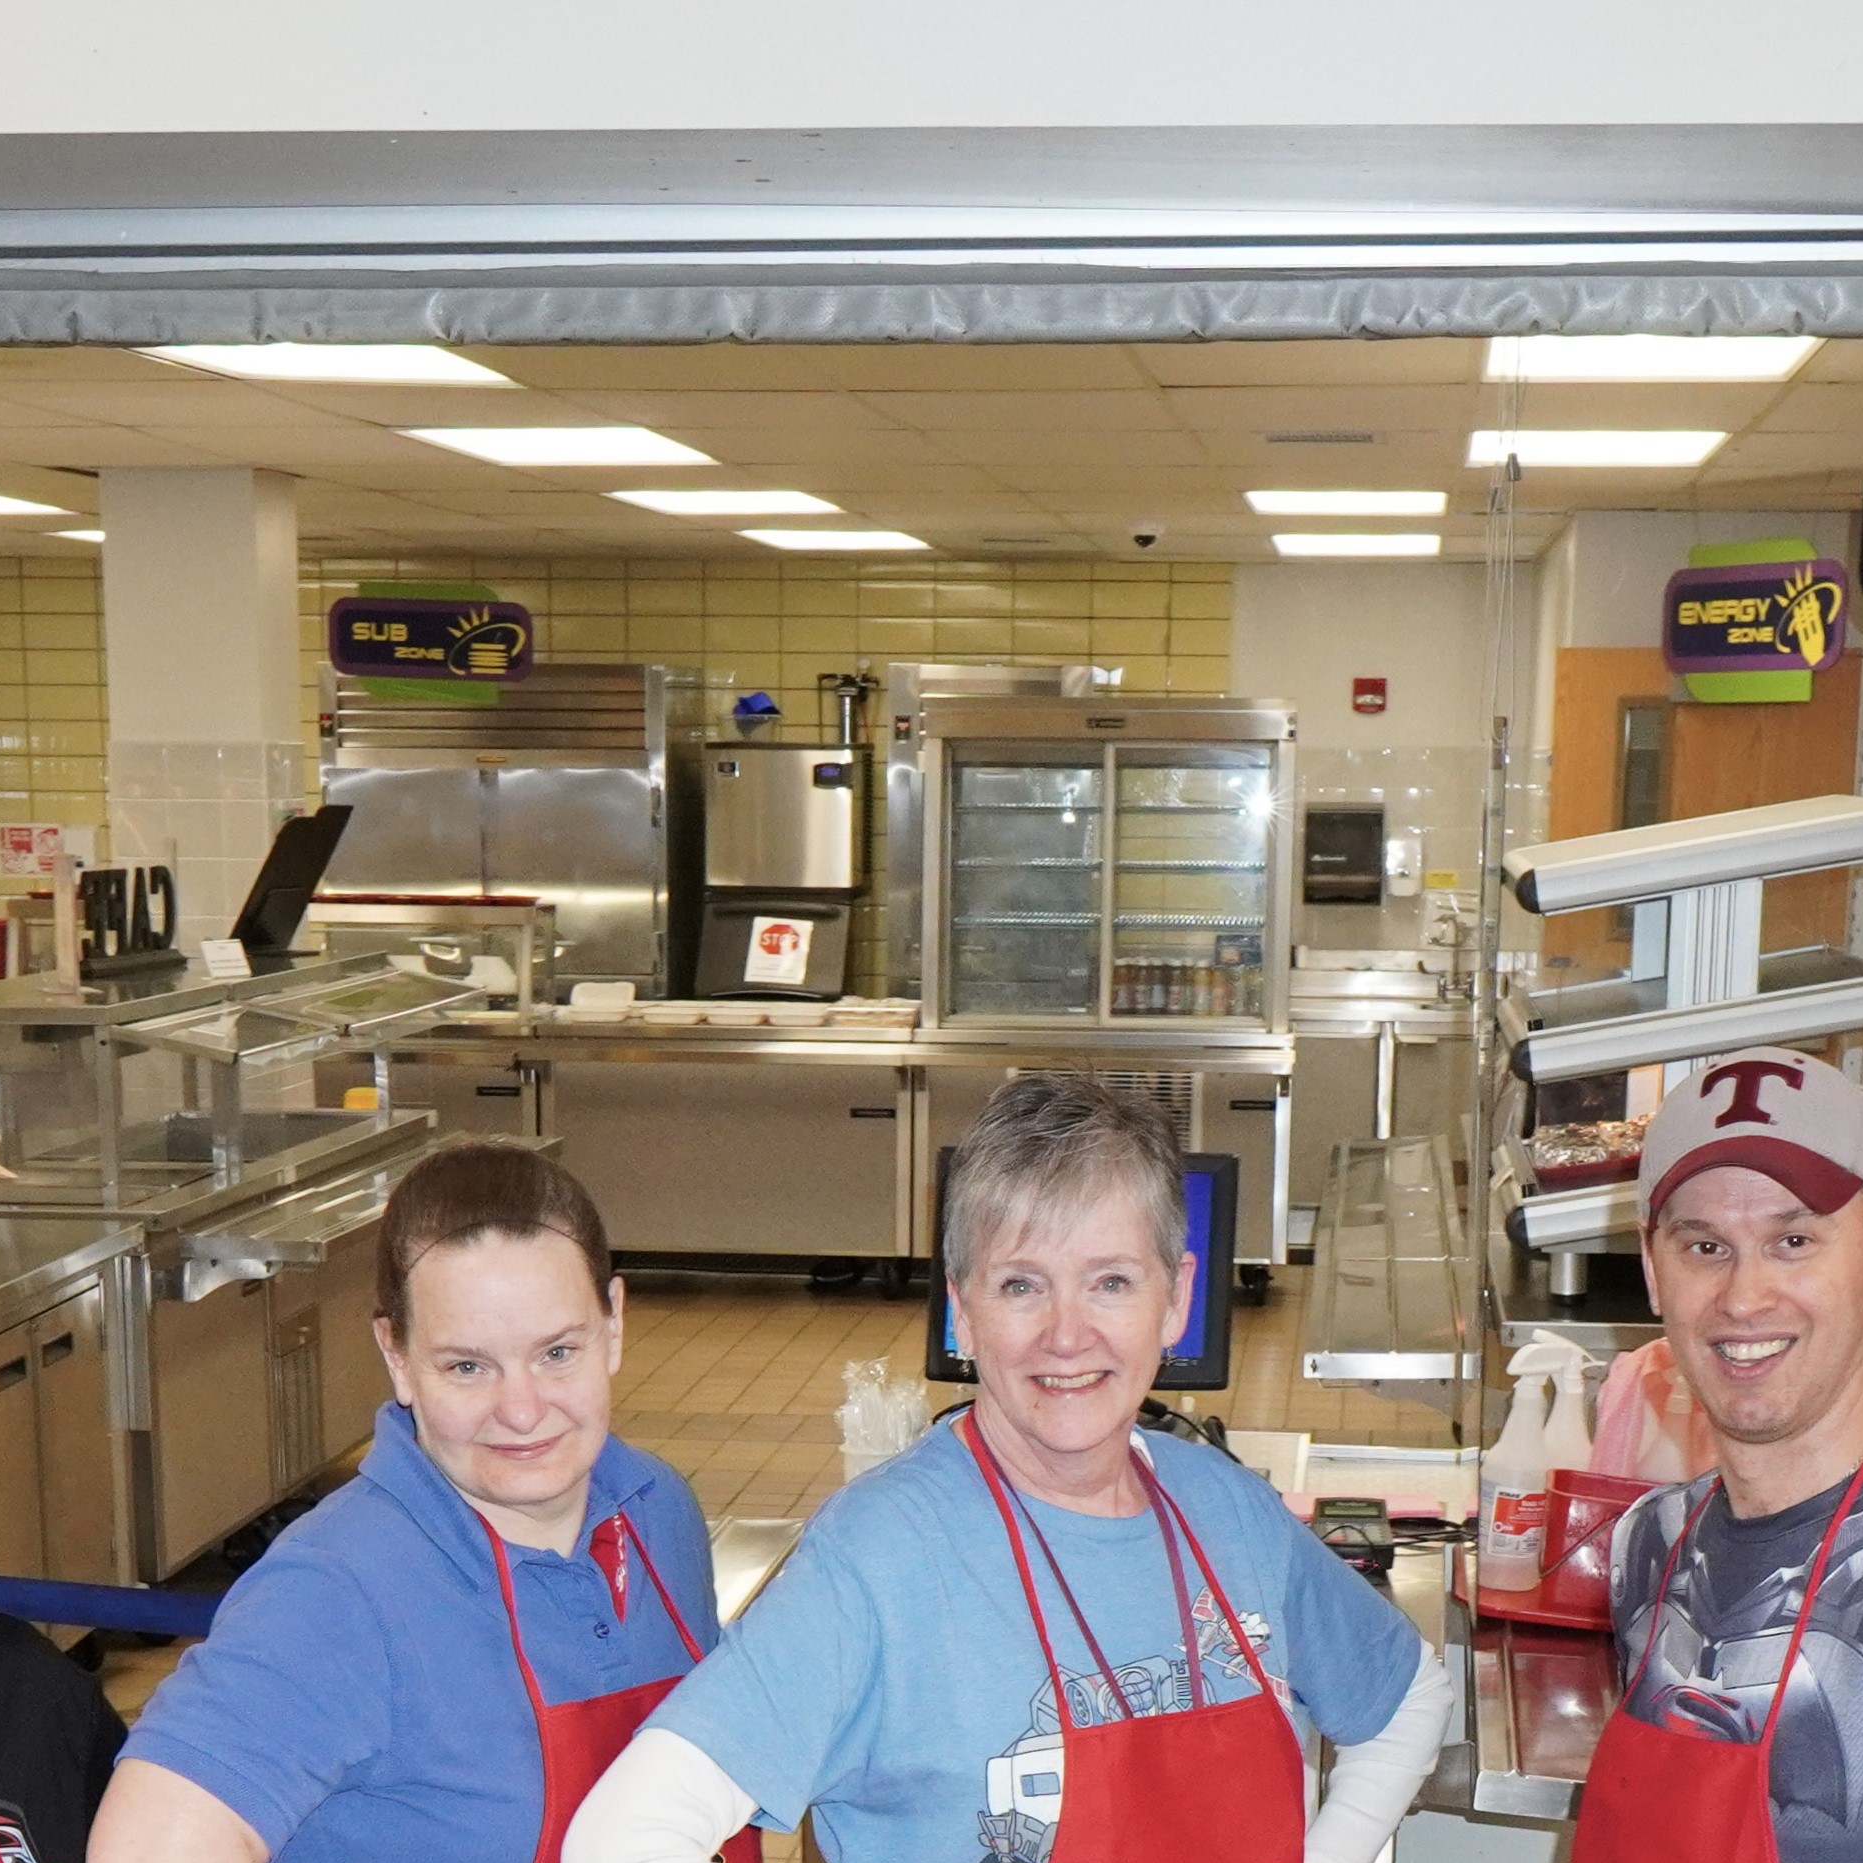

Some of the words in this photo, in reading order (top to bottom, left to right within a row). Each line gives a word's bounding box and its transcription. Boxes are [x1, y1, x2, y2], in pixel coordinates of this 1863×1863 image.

[1678, 598, 1771, 625] ENERGY
[351, 621, 408, 642] SUB
[1727, 627, 1774, 644] ZONE
[394, 647, 445, 660] ZONE
[761, 932, 801, 947] STOP
[1700, 1061, 1805, 1129] T
